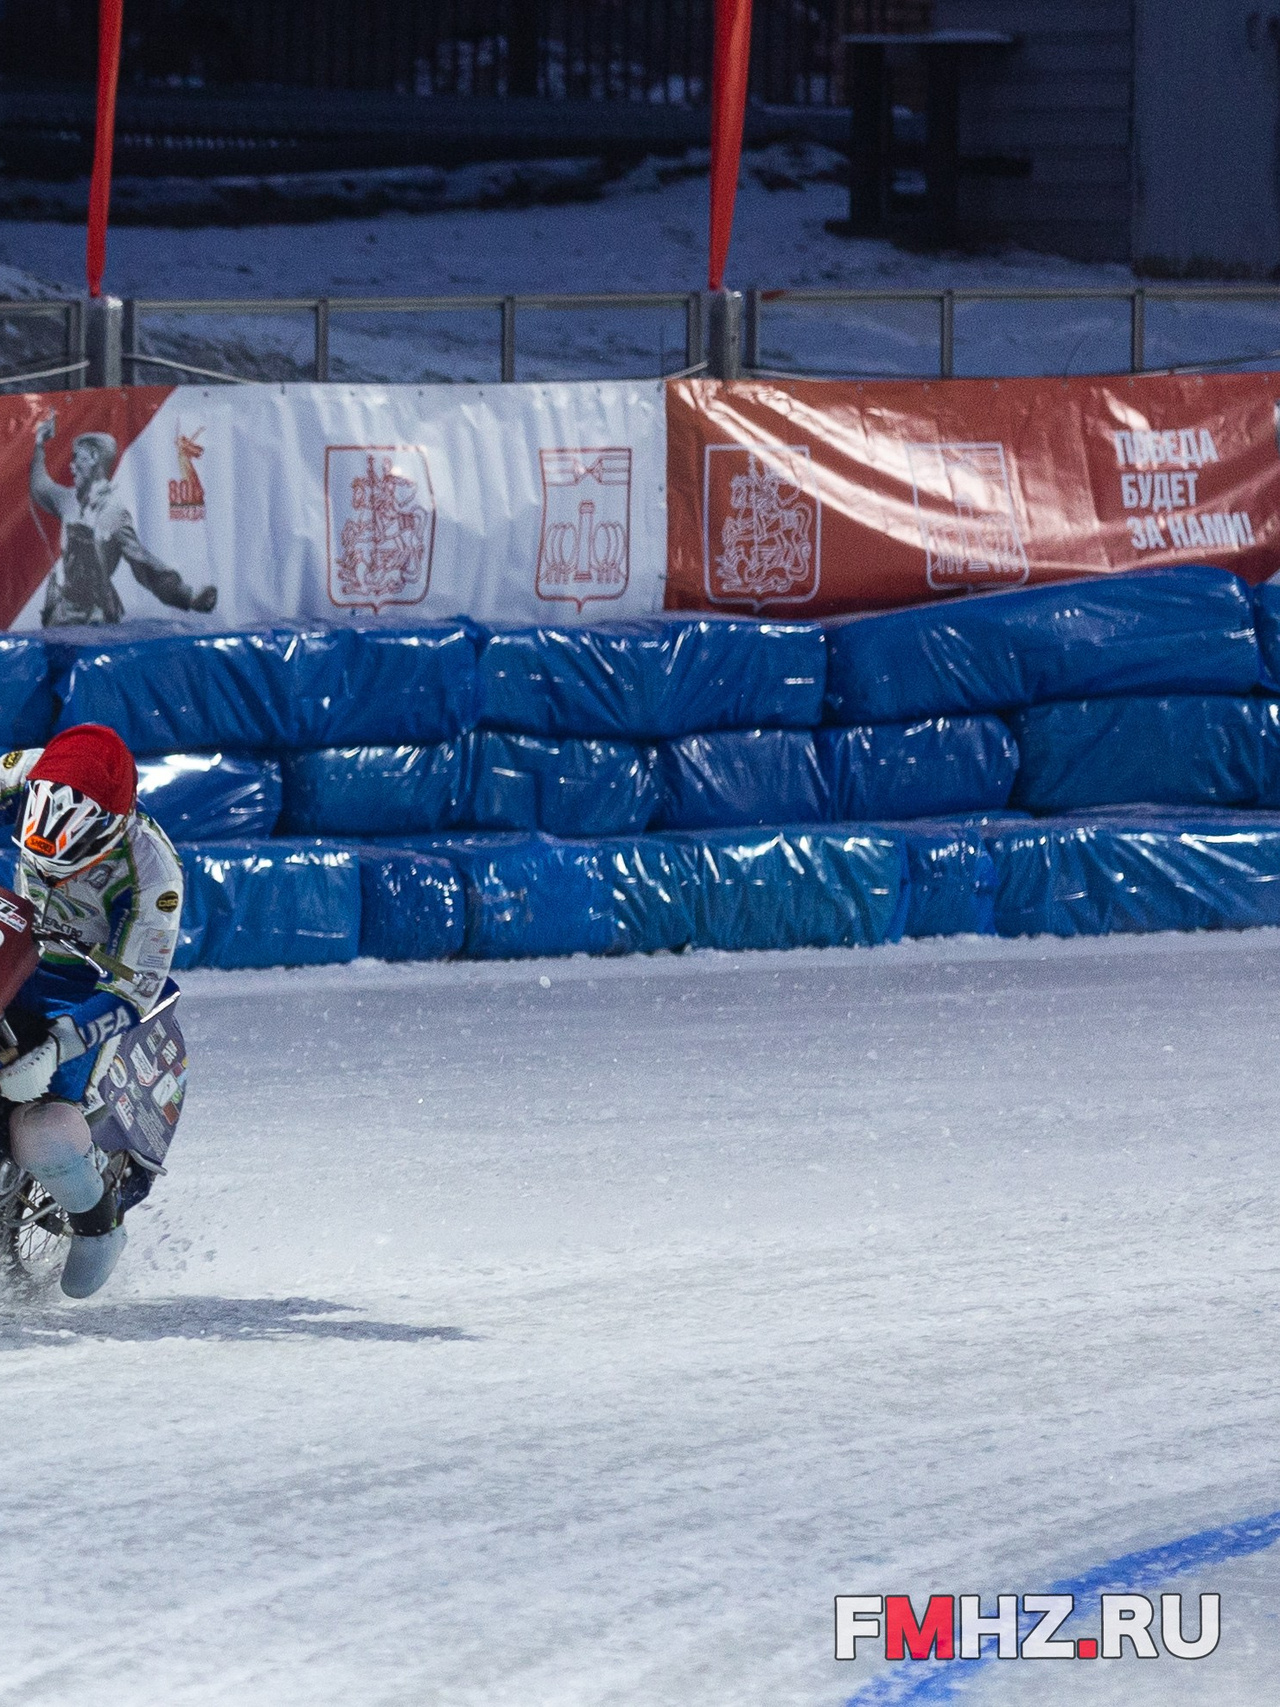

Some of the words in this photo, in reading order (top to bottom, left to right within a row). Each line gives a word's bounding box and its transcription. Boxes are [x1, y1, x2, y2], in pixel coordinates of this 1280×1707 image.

[1115, 428, 1219, 469] ПОБЕДА
[1121, 471, 1199, 513] БУДЕТ
[1126, 515, 1167, 550] ЗА
[1166, 511, 1257, 549] НАМИ!
